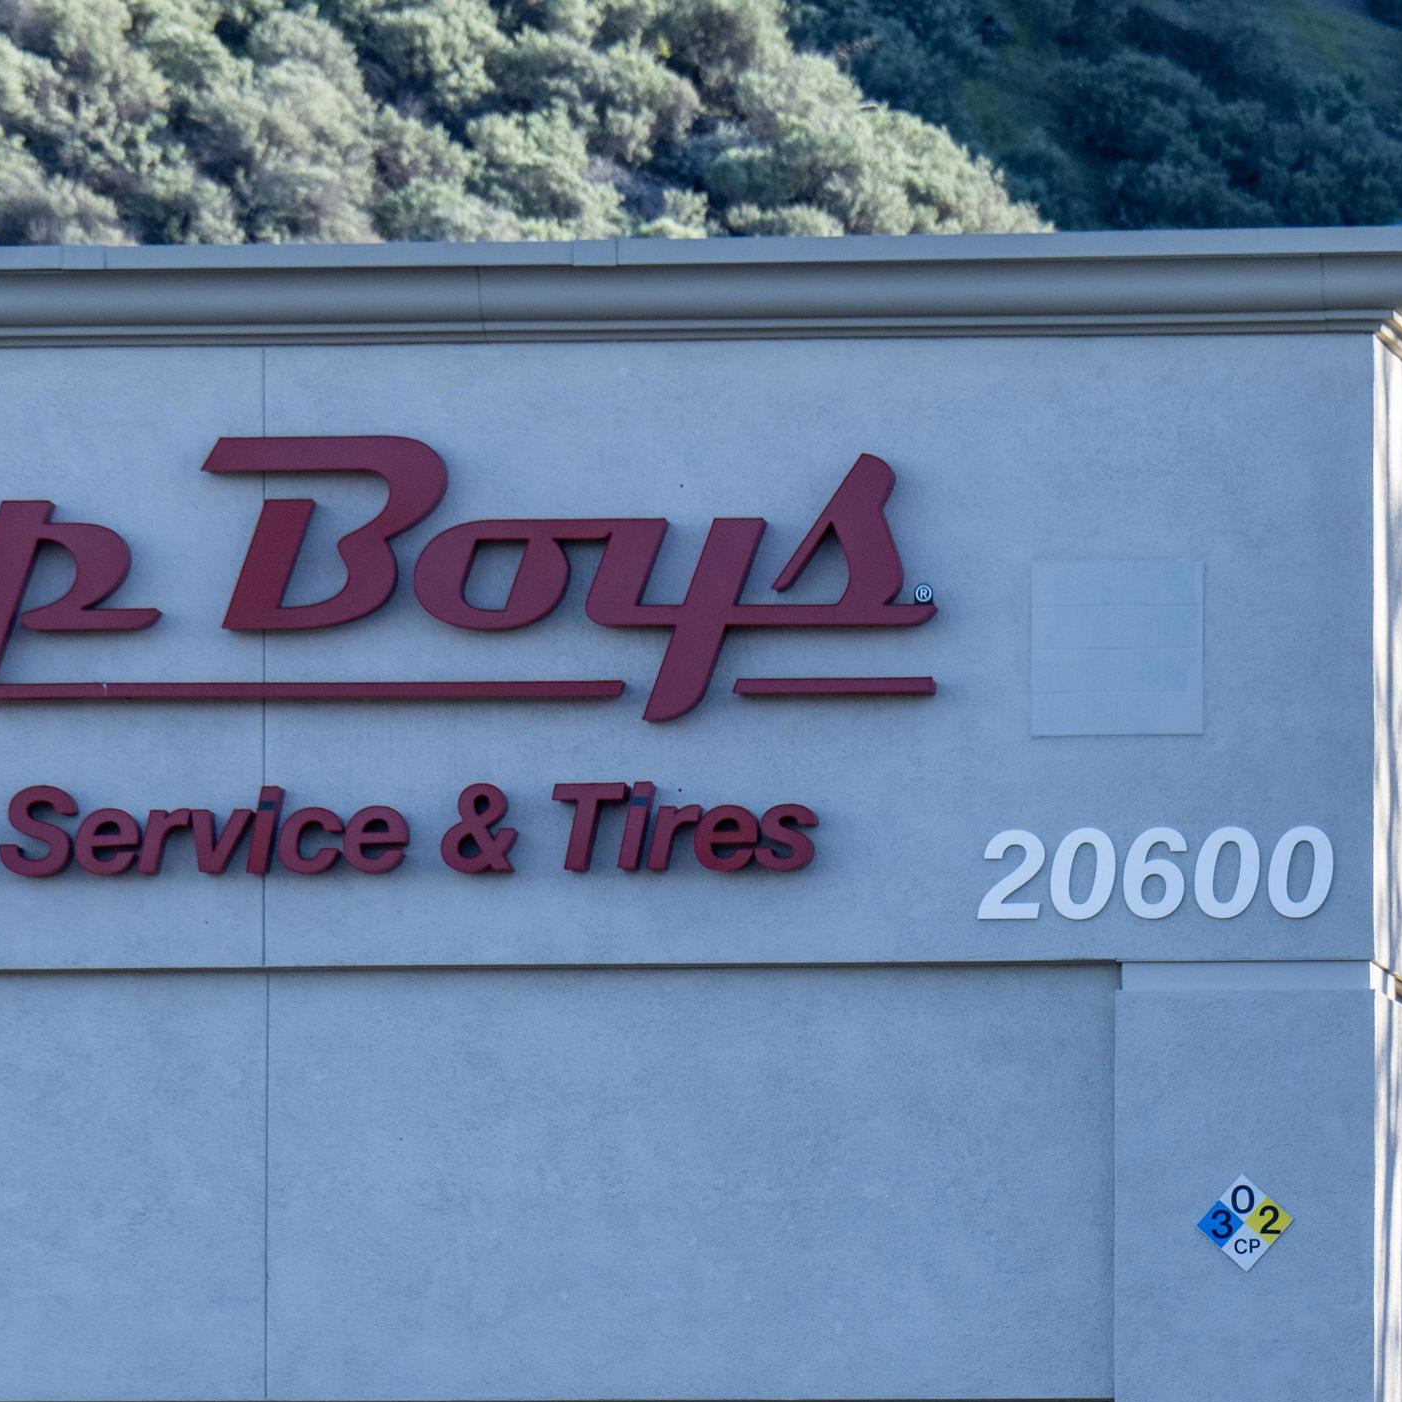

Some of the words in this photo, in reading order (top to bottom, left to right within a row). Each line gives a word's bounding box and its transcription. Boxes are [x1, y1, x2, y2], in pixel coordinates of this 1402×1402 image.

[201, 436, 938, 722] Boys
[440, 782, 519, 875] &
[552, 781, 819, 873] Tires
[977, 826, 1335, 921] 20600
[1211, 1209, 1234, 1239] 3
[1259, 1205, 1281, 1235] 2
[1231, 1185, 1255, 1214] 0
[1234, 1238, 1260, 1255] CP
